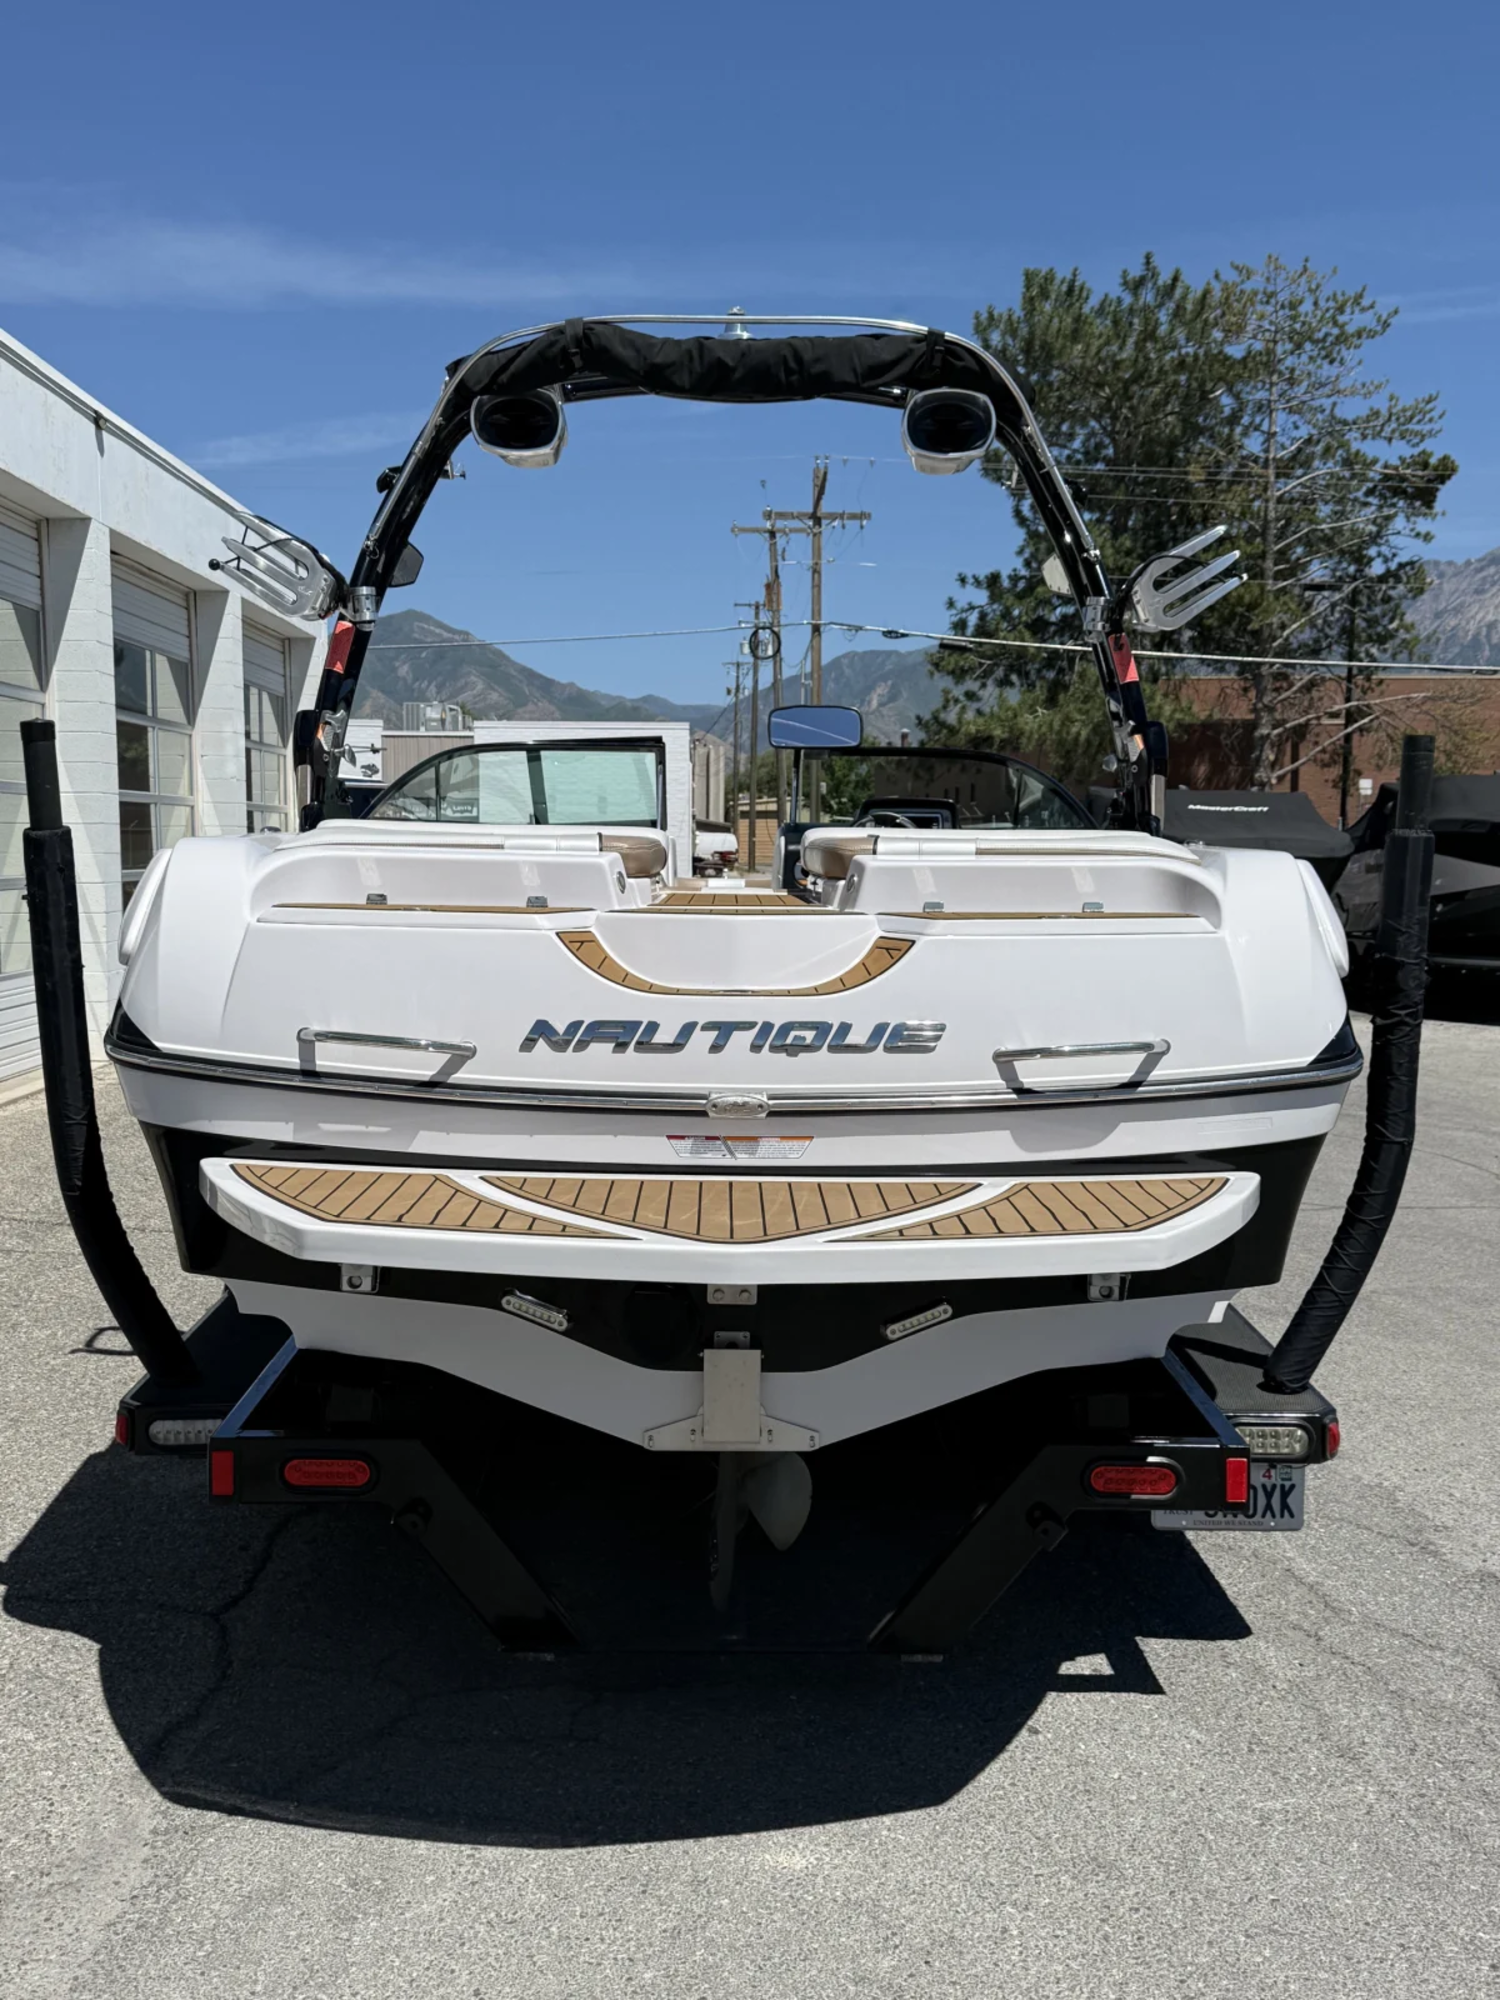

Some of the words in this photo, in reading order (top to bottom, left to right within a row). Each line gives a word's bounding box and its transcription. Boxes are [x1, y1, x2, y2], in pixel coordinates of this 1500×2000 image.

[1187, 804, 1269, 812] MasterCraft
[518, 1018, 948, 1057] NAUTIQUE
[1262, 1468, 1273, 1480] 4
[1237, 1519, 1264, 1527] STAND
